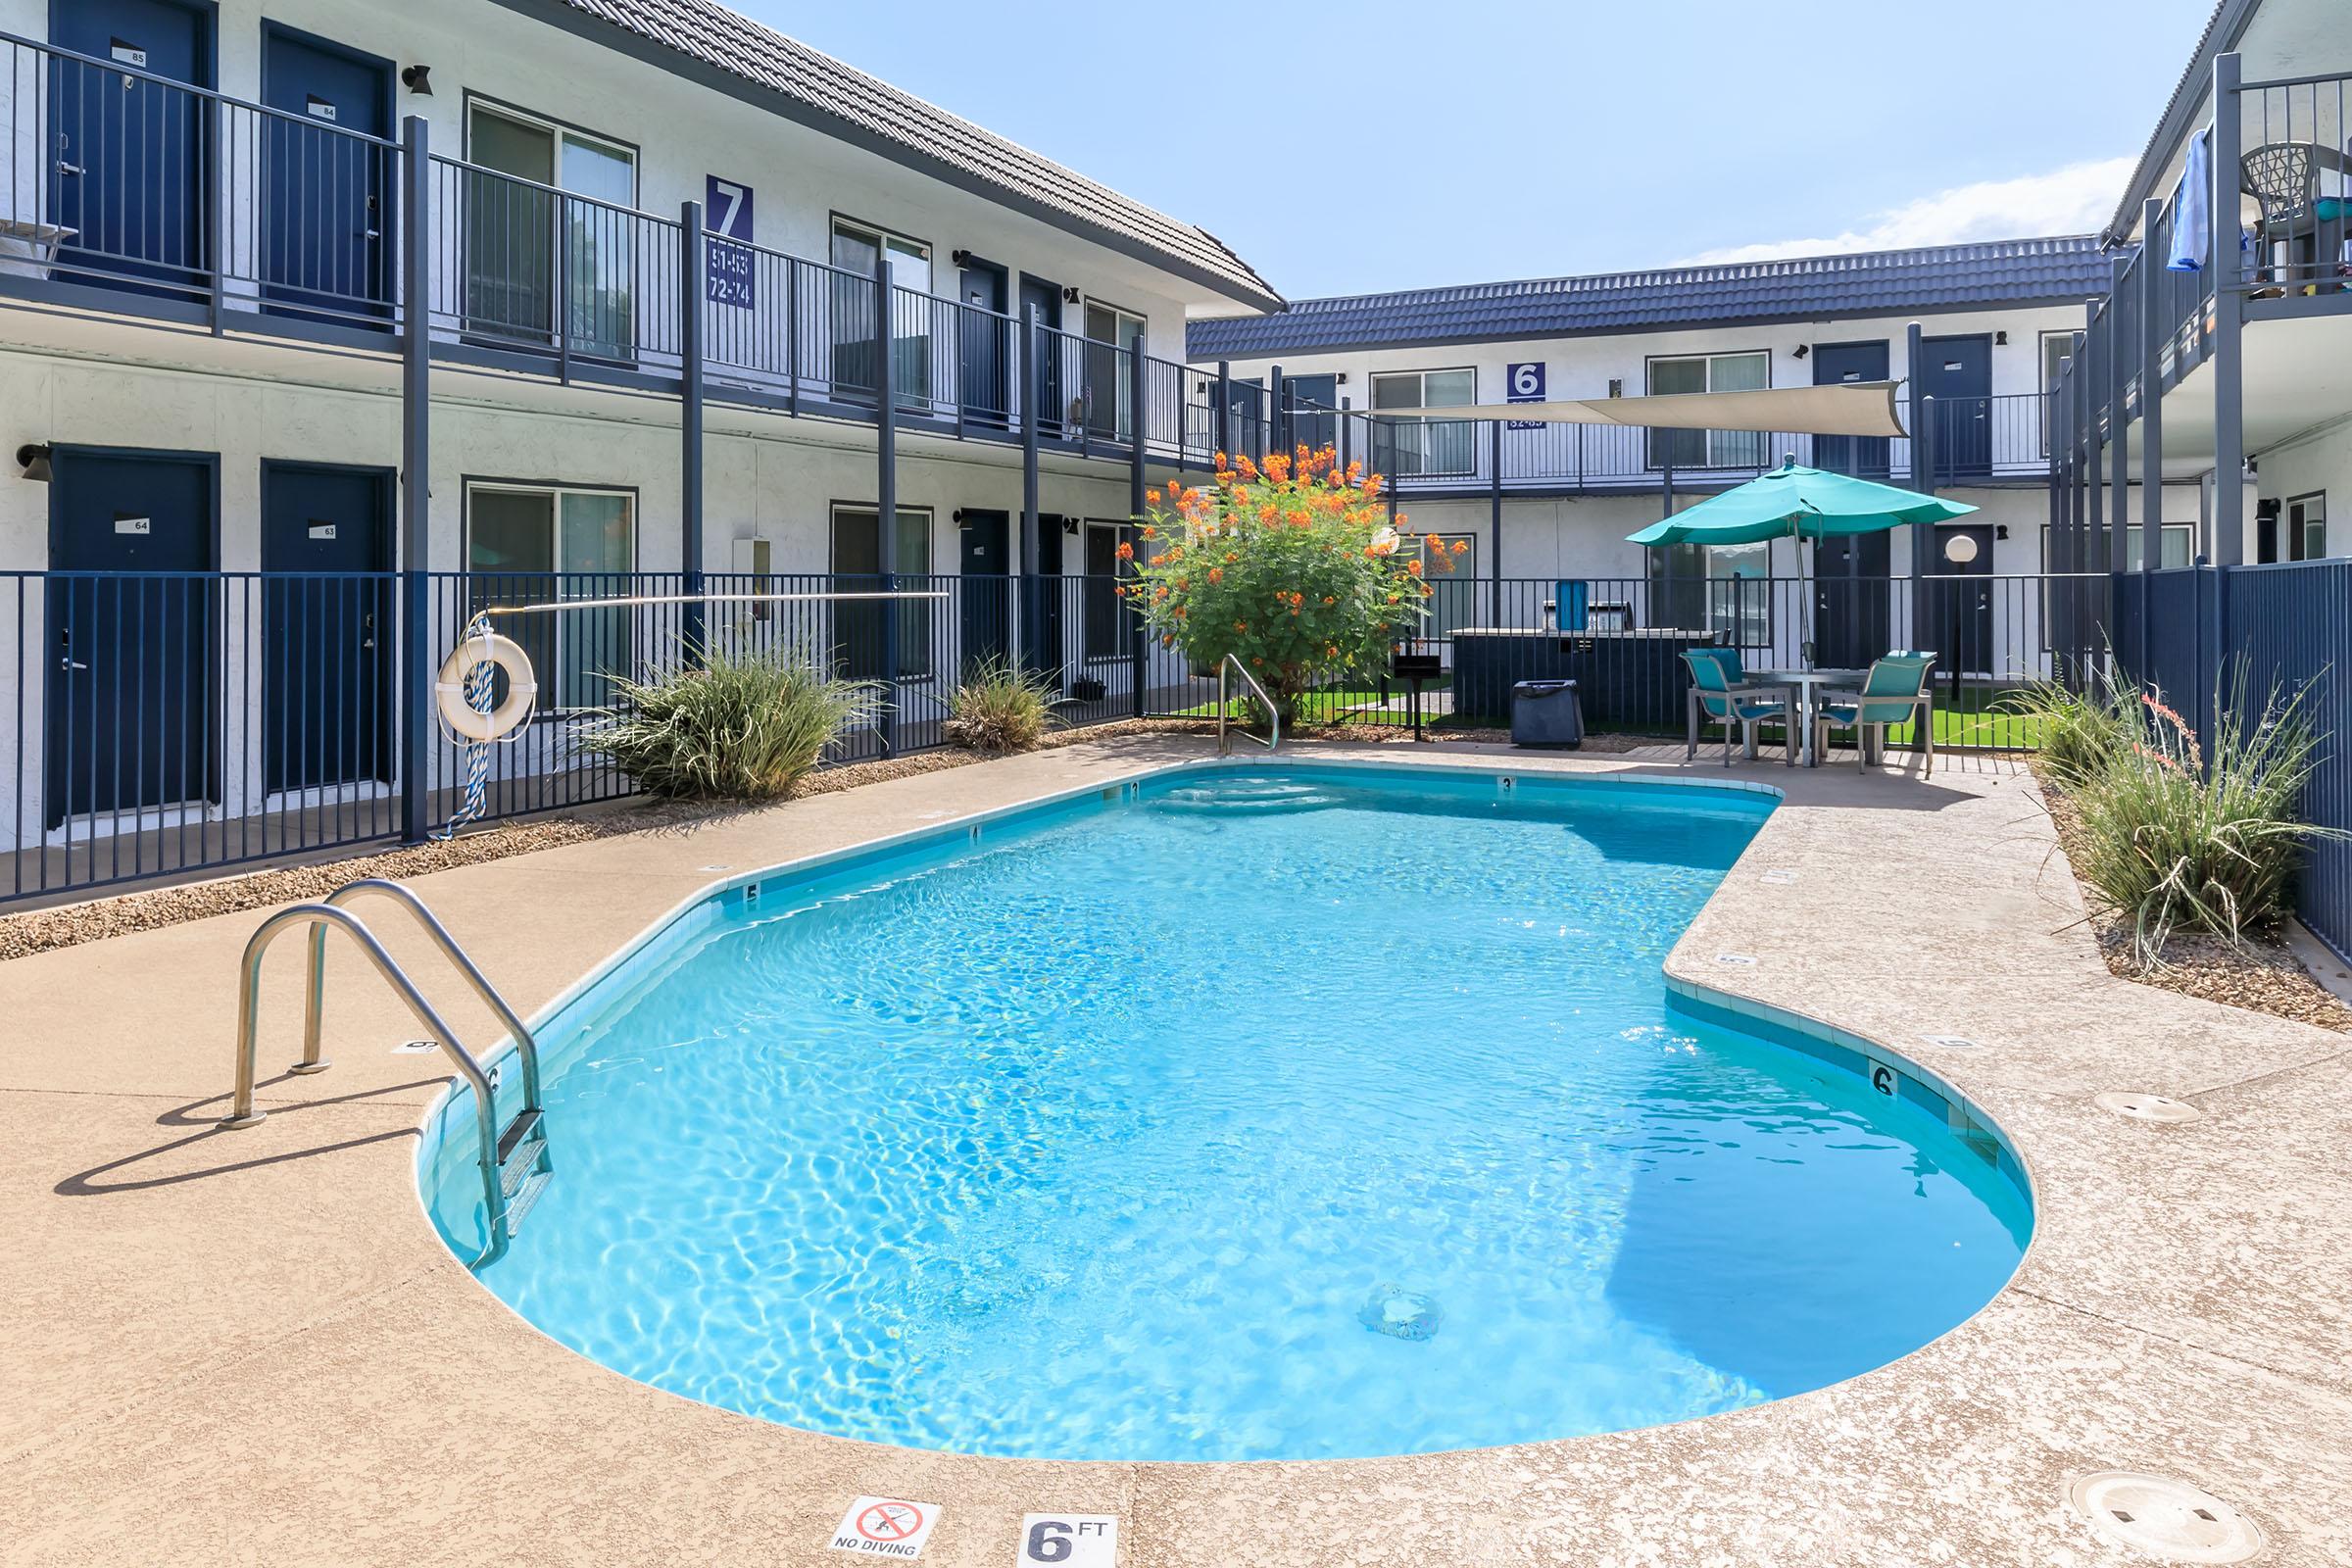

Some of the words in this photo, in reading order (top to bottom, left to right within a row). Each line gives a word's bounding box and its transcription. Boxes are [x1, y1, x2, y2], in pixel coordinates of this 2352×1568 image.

[132, 52, 144, 63] 85
[323, 107, 334, 117] 84
[717, 180, 744, 237] 7
[710, 276, 750, 305] 72-74
[1514, 364, 1539, 395] 6
[135, 521, 148, 530] 64
[747, 884, 757, 903] 5
[1874, 1066, 1893, 1096] 6
[835, 1537, 858, 1548] NO
[861, 1540, 916, 1556] DIVING
[1027, 1521, 1073, 1563] 6
[1079, 1522, 1108, 1537] FT
